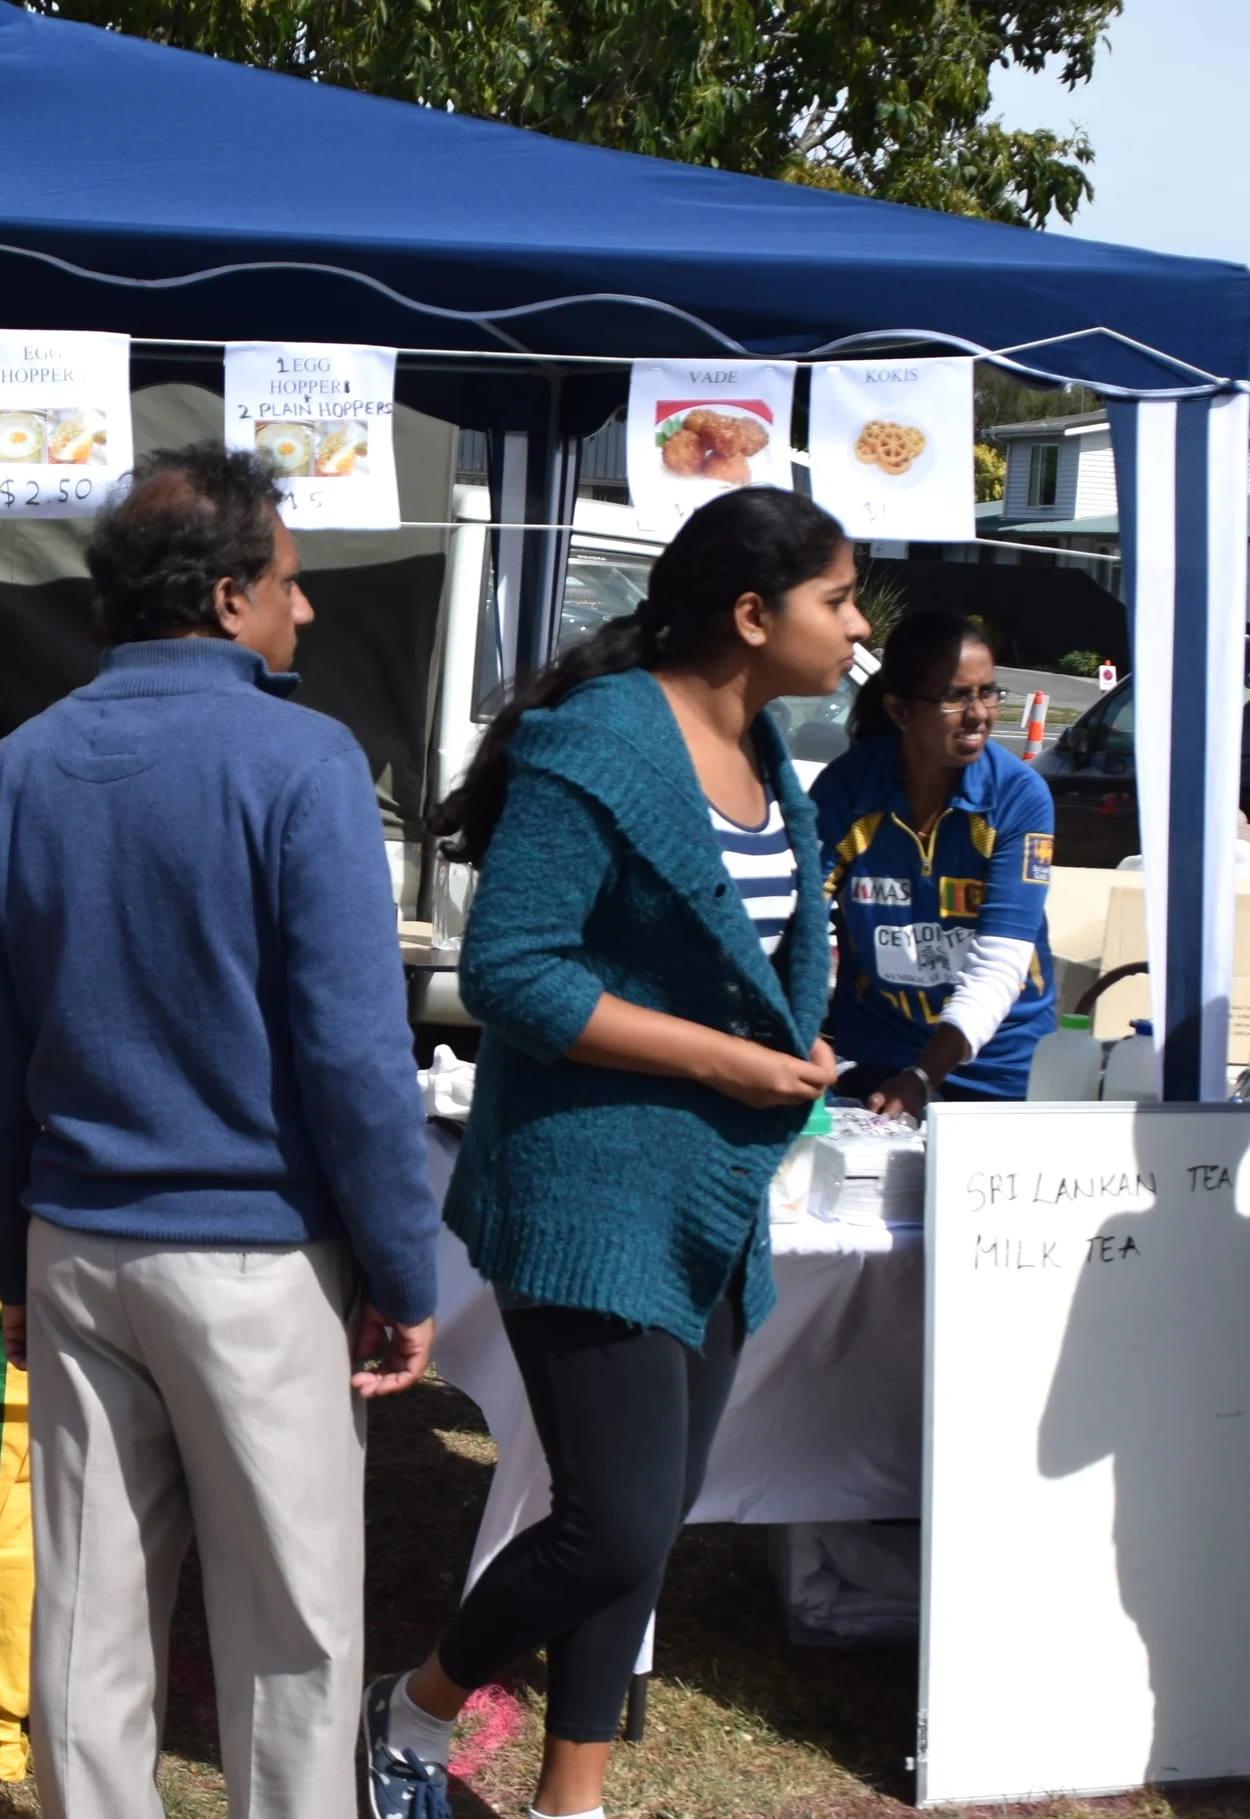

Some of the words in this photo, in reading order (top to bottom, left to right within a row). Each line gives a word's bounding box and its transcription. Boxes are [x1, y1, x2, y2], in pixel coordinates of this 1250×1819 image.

[292, 357, 332, 373] EGG
[864, 367, 920, 384] KOKIS
[689, 369, 739, 385] VADE
[237, 403, 253, 420] 2
[259, 402, 313, 418] PLAIN
[318, 399, 394, 418] HOPPERS
[870, 881, 911, 902] MAS
[966, 1171, 1018, 1213] SRI
[1033, 1171, 1158, 1205] LANKAN
[1187, 1164, 1234, 1193] TEA
[974, 1233, 1062, 1270] MILK
[1085, 1235, 1141, 1264] TEA
